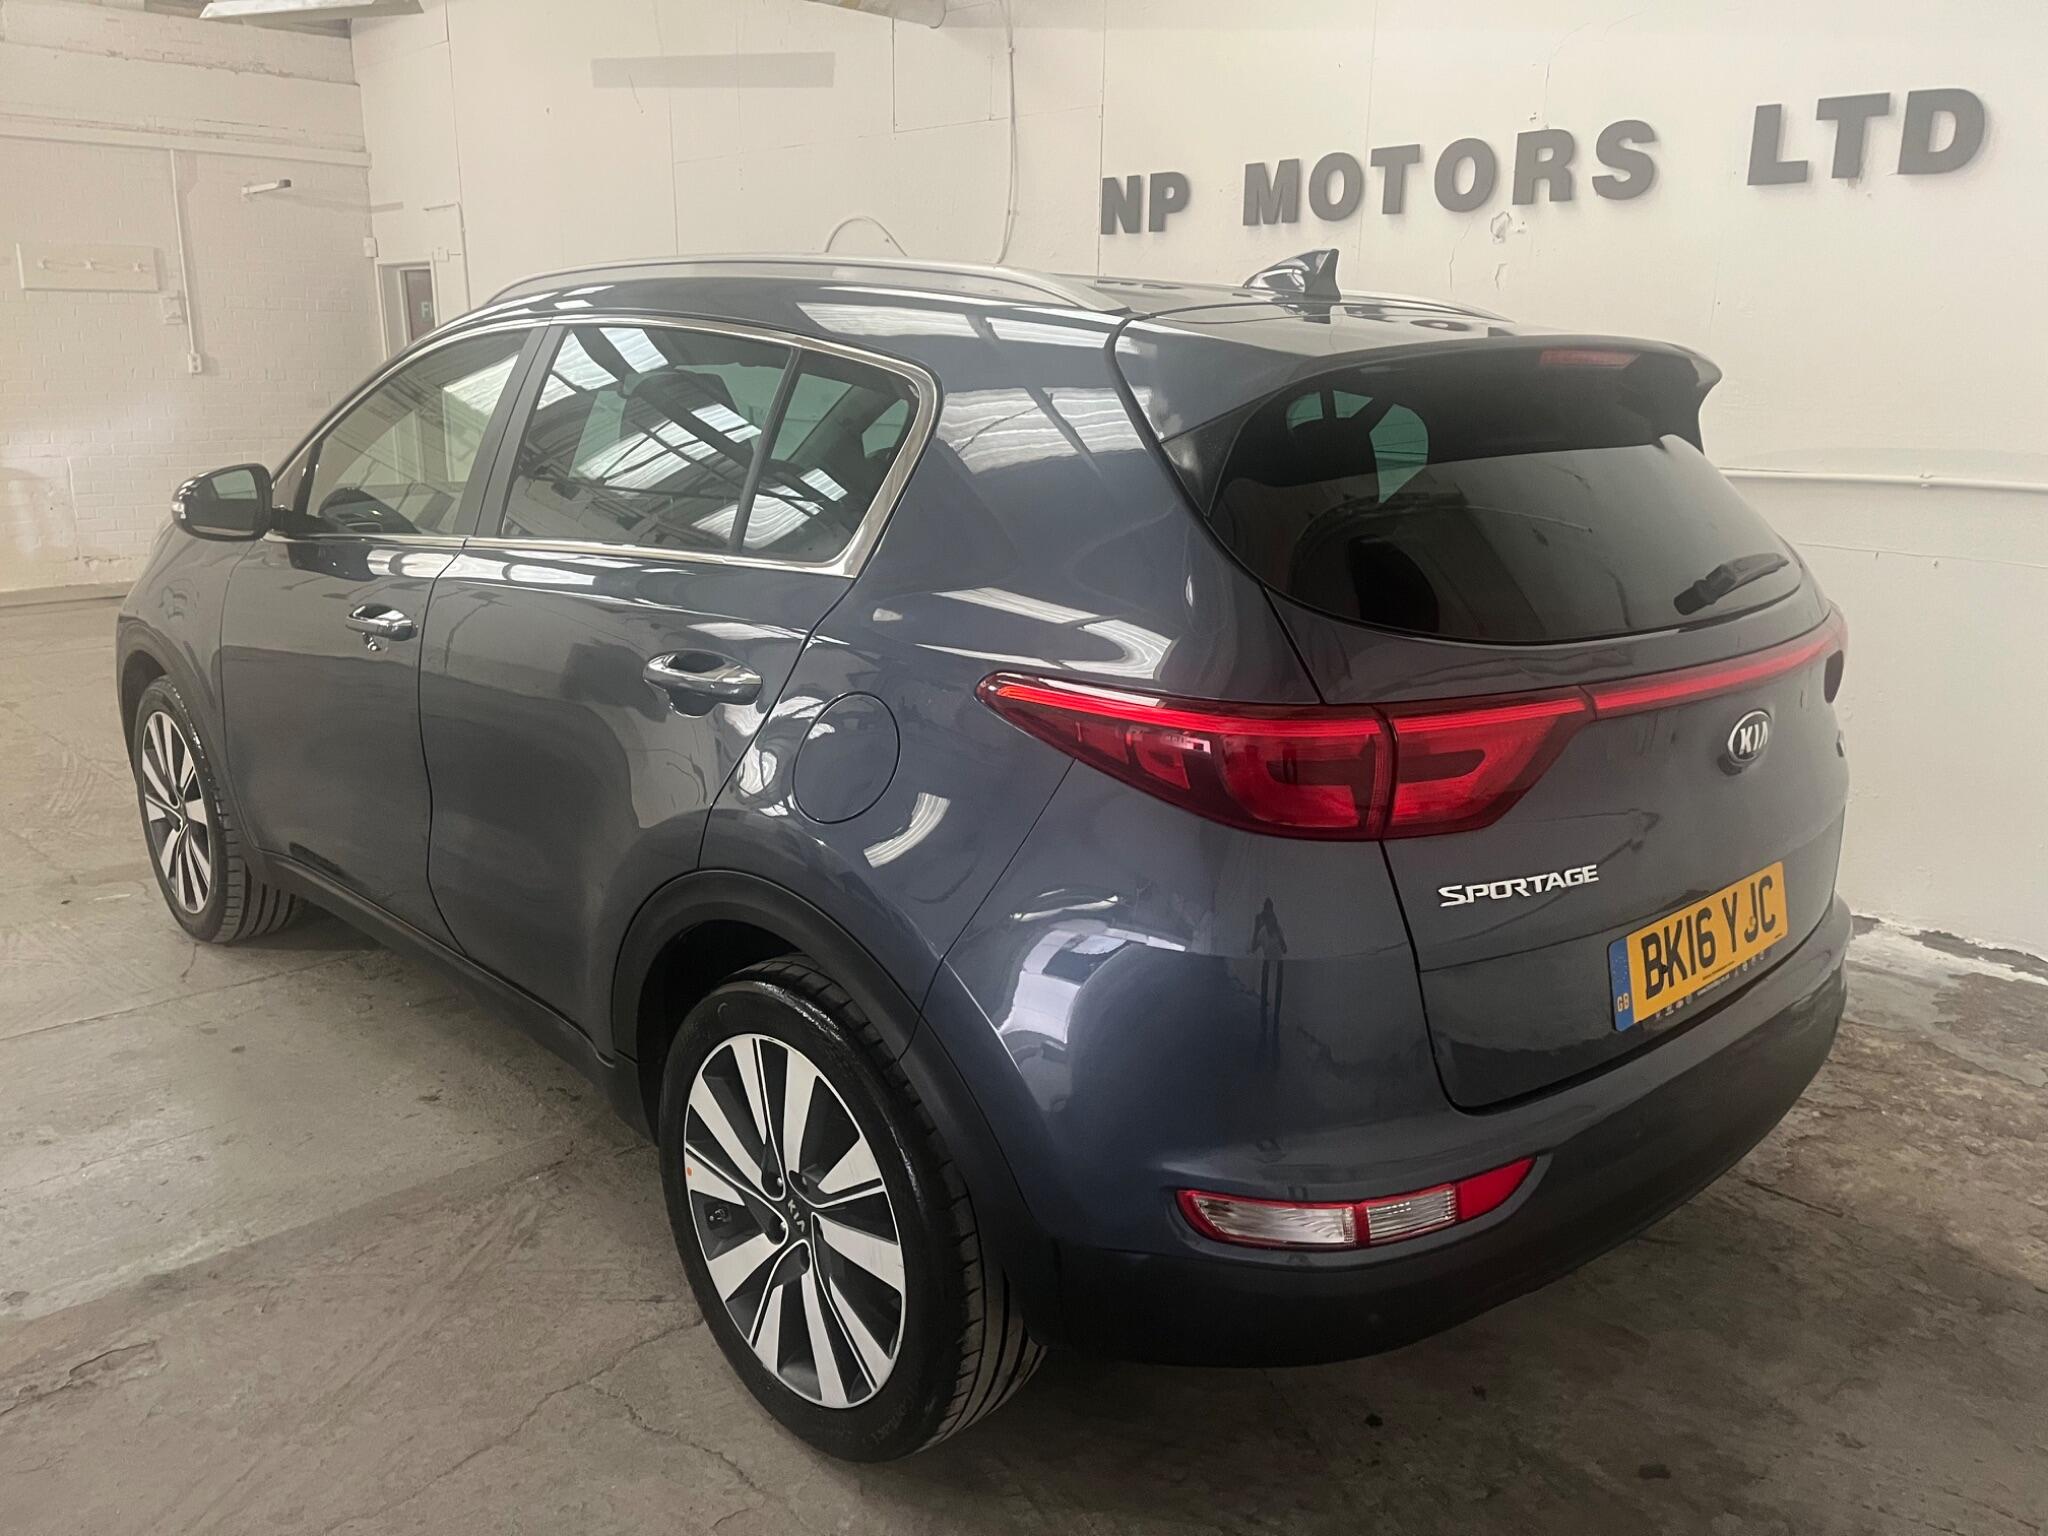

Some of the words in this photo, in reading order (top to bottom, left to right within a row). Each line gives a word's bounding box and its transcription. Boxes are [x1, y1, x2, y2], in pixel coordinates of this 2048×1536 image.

[1100, 172, 1190, 234] NP
[1243, 120, 1658, 226] MOTORS
[1747, 88, 1986, 186] LTD
[1738, 720, 1768, 755] KIA
[1438, 864, 1599, 907] SPORTAGE
[1641, 906, 1716, 999] BK16
[1722, 875, 1776, 952] YJC
[1616, 993, 1630, 1012] GB
[787, 1199, 805, 1232] KIA
